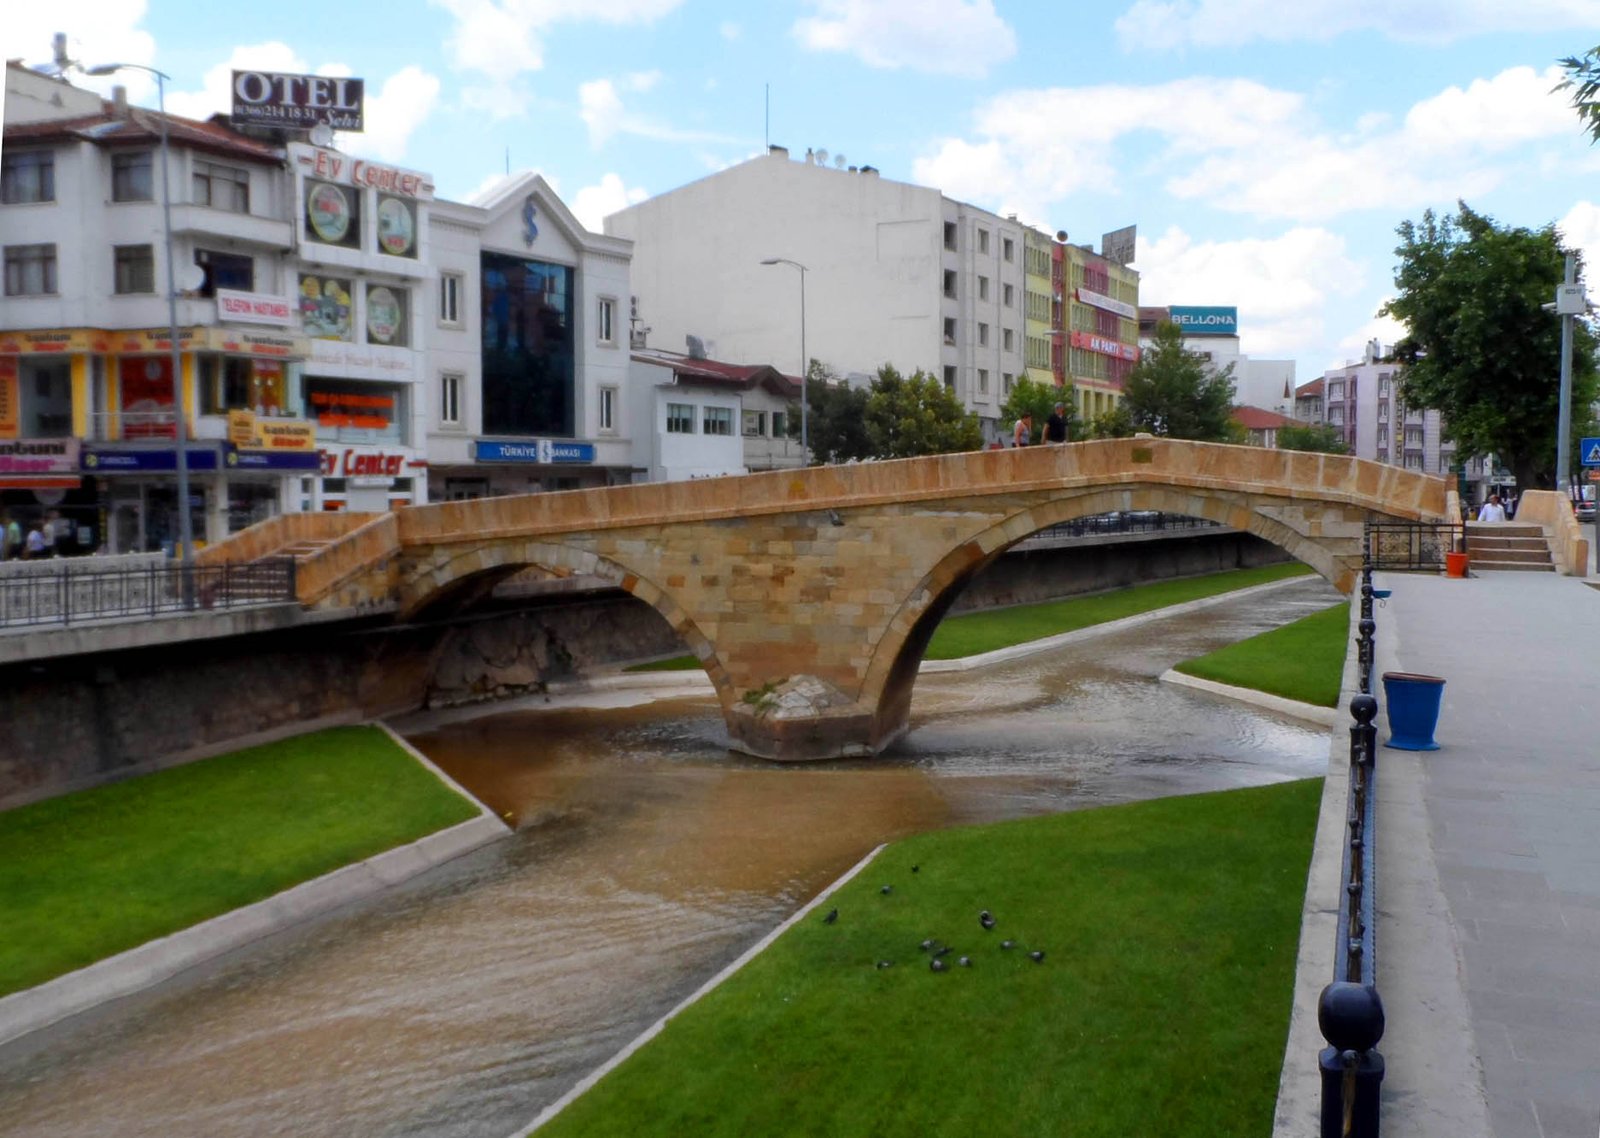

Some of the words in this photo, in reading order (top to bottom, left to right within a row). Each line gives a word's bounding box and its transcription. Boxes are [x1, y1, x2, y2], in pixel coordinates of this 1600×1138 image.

[235, 72, 359, 110] OTEL
[287, 107, 301, 118] 18
[303, 108, 317, 119] 31
[316, 150, 341, 176] Ev
[352, 160, 422, 195] Center
[1171, 315, 1234, 325] BELLONA
[500, 445, 535, 457] TÜRKİYE
[343, 449, 405, 475] Center
